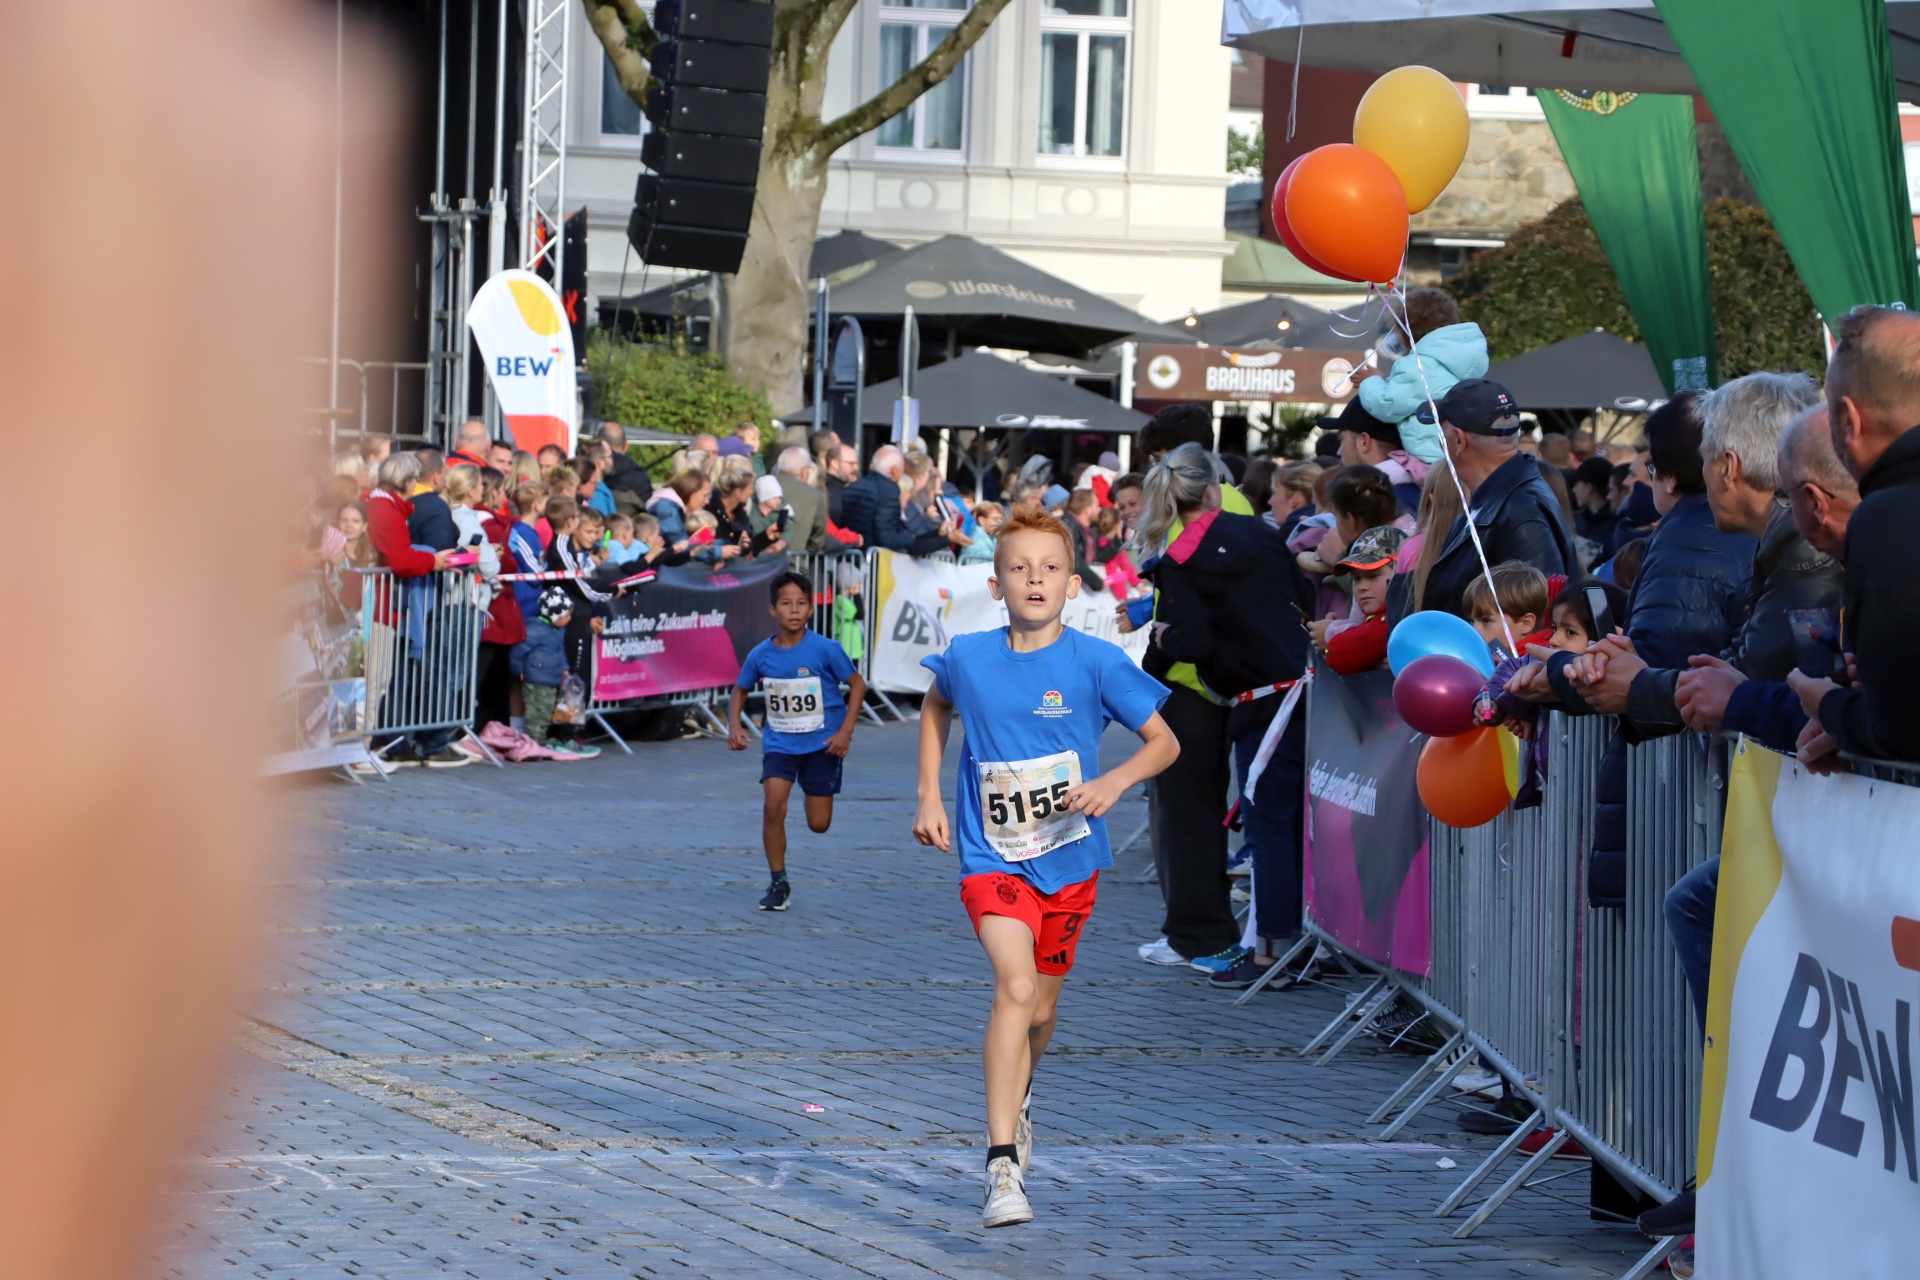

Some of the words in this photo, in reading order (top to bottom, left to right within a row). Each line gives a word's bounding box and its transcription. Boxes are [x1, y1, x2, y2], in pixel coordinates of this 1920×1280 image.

[949, 280, 1076, 311] Warsteiner
[496, 356, 553, 377] BEW
[1206, 366, 1295, 394] BRAUHAUS
[631, 613, 656, 632] eine
[655, 610, 698, 631] Zukunft
[700, 609, 726, 628] voller
[601, 635, 666, 662] Möglikeiten.
[769, 694, 817, 712] 5139
[988, 780, 1070, 826] 5155
[1014, 847, 1039, 859] VOSS
[1040, 841, 1057, 852] BEW
[1059, 914, 1082, 943] 9
[1749, 952, 1918, 1184] BEW
